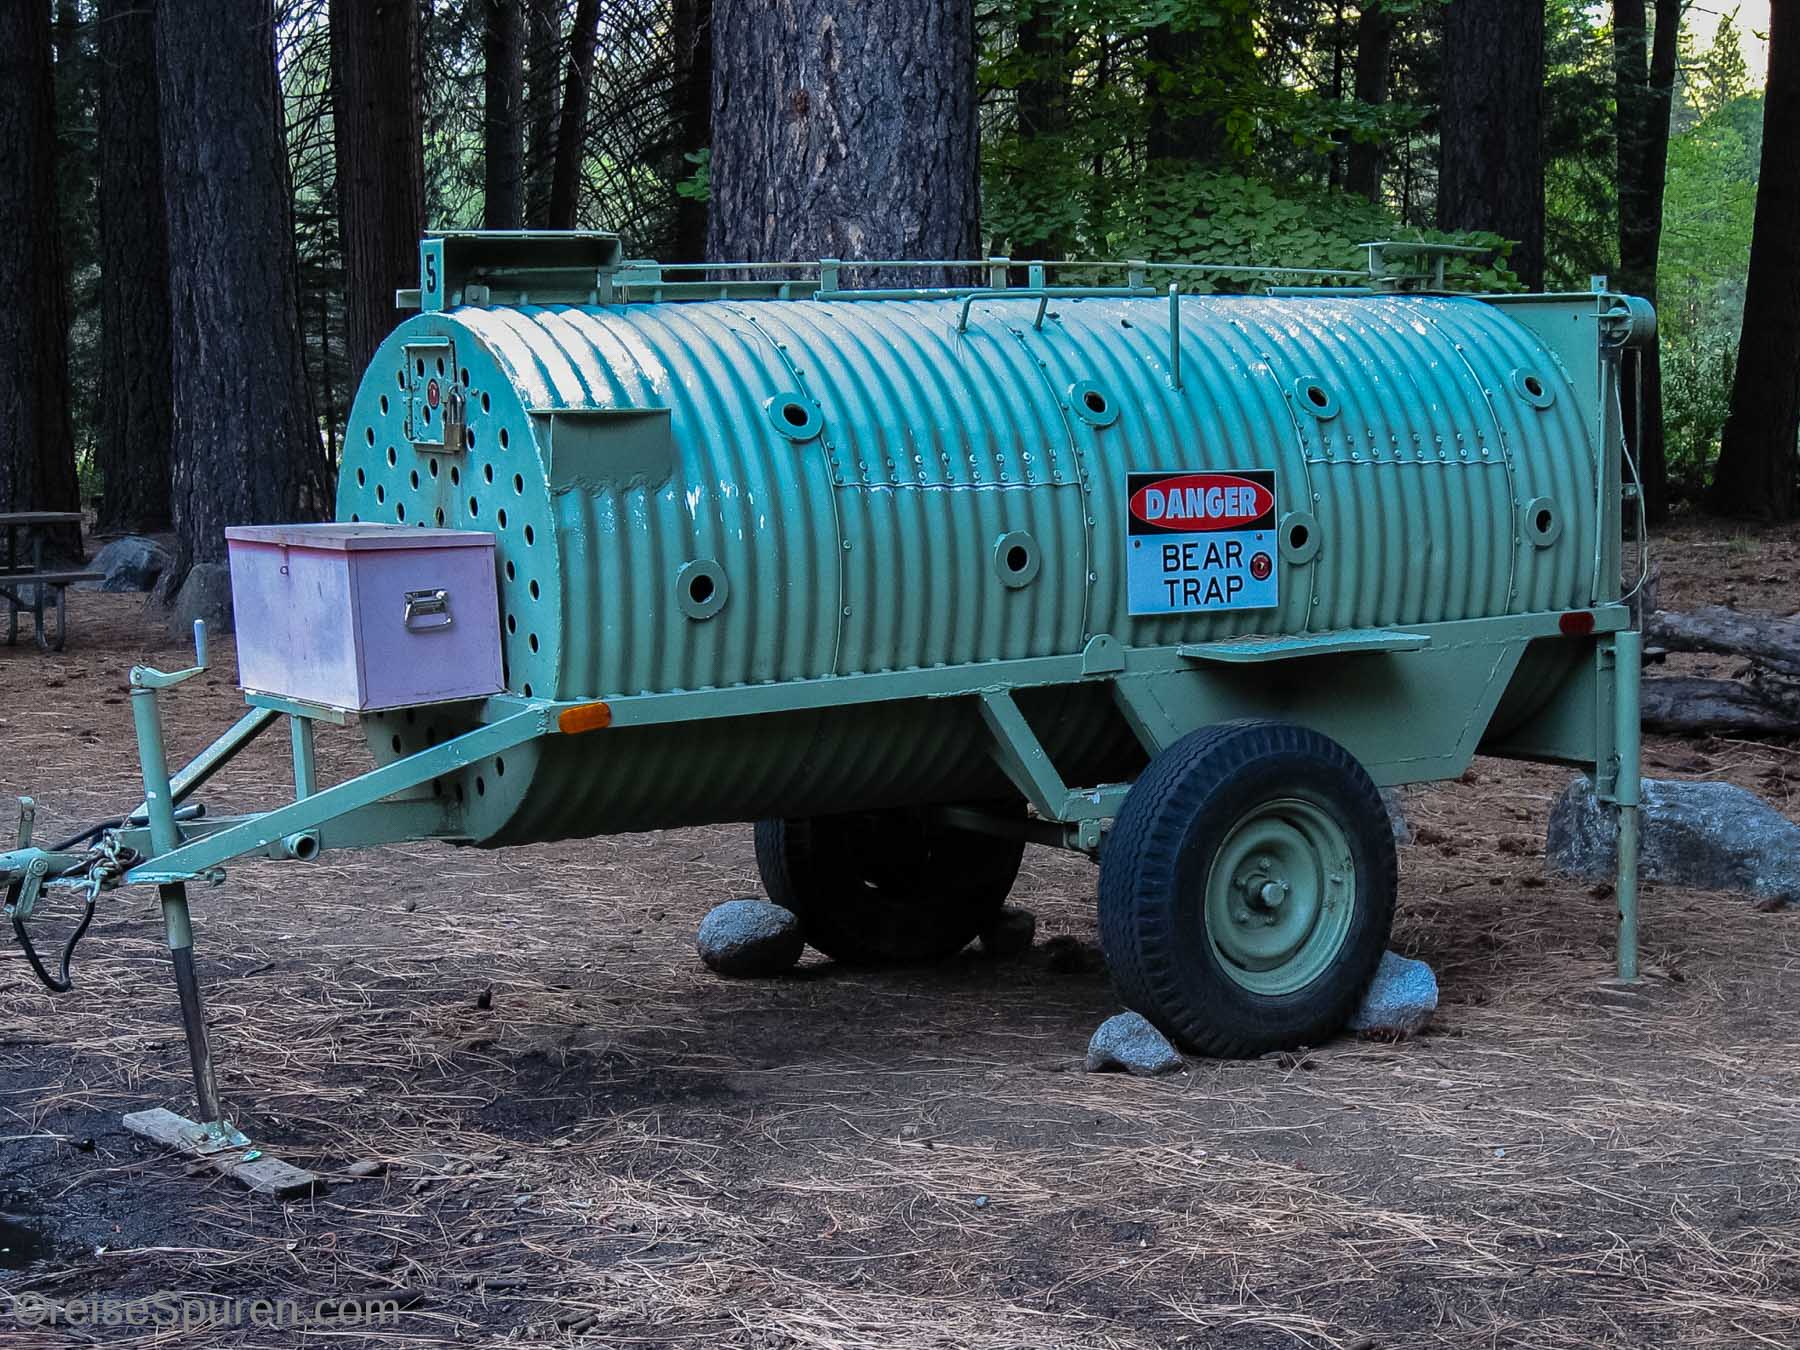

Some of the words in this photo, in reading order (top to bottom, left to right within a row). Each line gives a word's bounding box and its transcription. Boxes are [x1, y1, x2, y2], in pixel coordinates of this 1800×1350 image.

[425, 253, 437, 294] 5
[1145, 486, 1258, 520] DANGER
[1162, 540, 1243, 573] BEAR
[1163, 575, 1243, 608] TRAP
